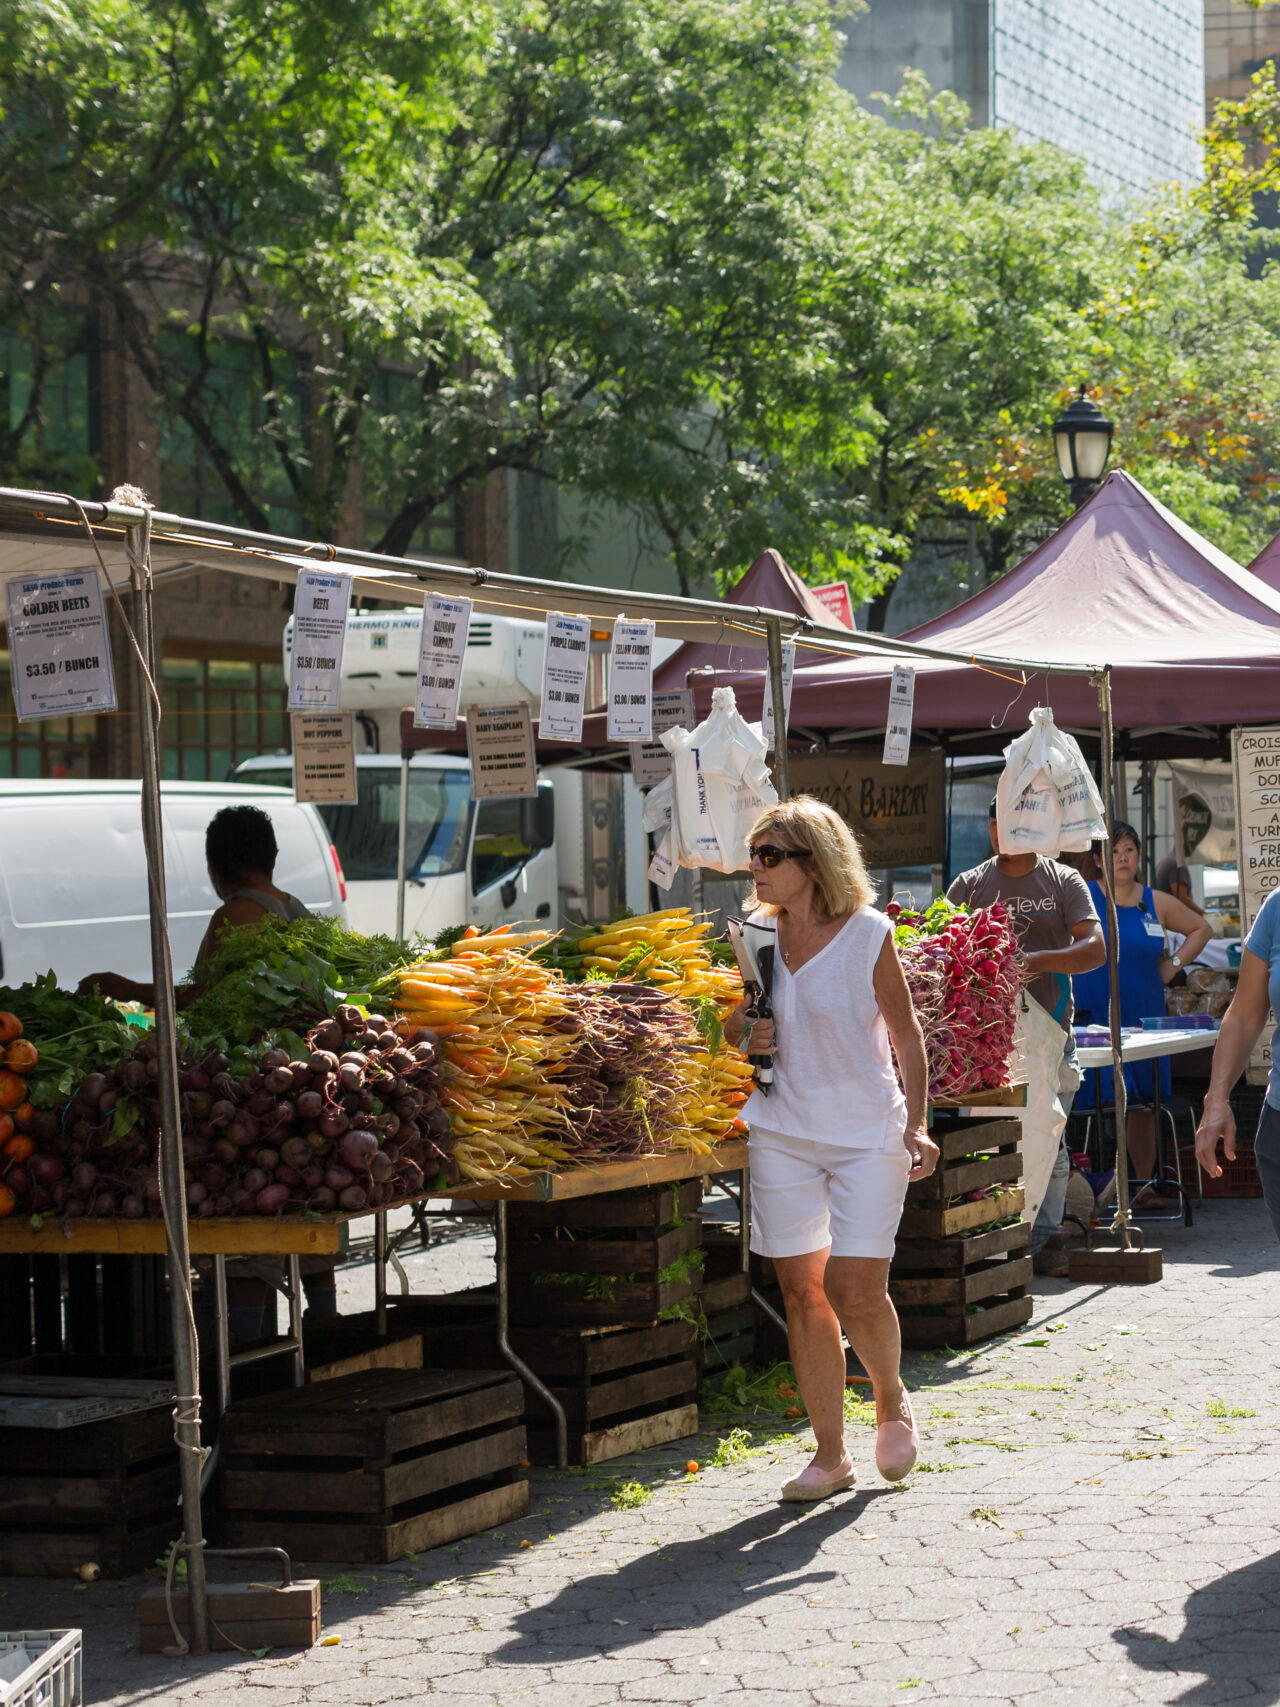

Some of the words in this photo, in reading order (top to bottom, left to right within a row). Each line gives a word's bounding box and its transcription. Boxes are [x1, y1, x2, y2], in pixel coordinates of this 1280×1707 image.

[40, 580, 64, 590] Produce
[66, 578, 84, 586] Farms
[23, 600, 59, 616] GOLDEN
[62, 596, 90, 611] BEETS
[313, 598, 329, 610] BEETS
[349, 622, 389, 630] HERMO
[393, 622, 420, 630] KING
[550, 636, 566, 648] PURPLE
[26, 662, 55, 678] $3.50
[58, 661, 62, 673] /
[66, 656, 99, 672] BUNCH
[317, 657, 336, 669] BUNCH
[438, 676, 455, 689] BUNCH
[565, 691, 579, 704] BUNCH
[631, 694, 646, 704] BUNCH
[476, 724, 491, 732] BABY
[493, 722, 523, 731] EGGPLANT
[317, 729, 342, 738] PEPPERS
